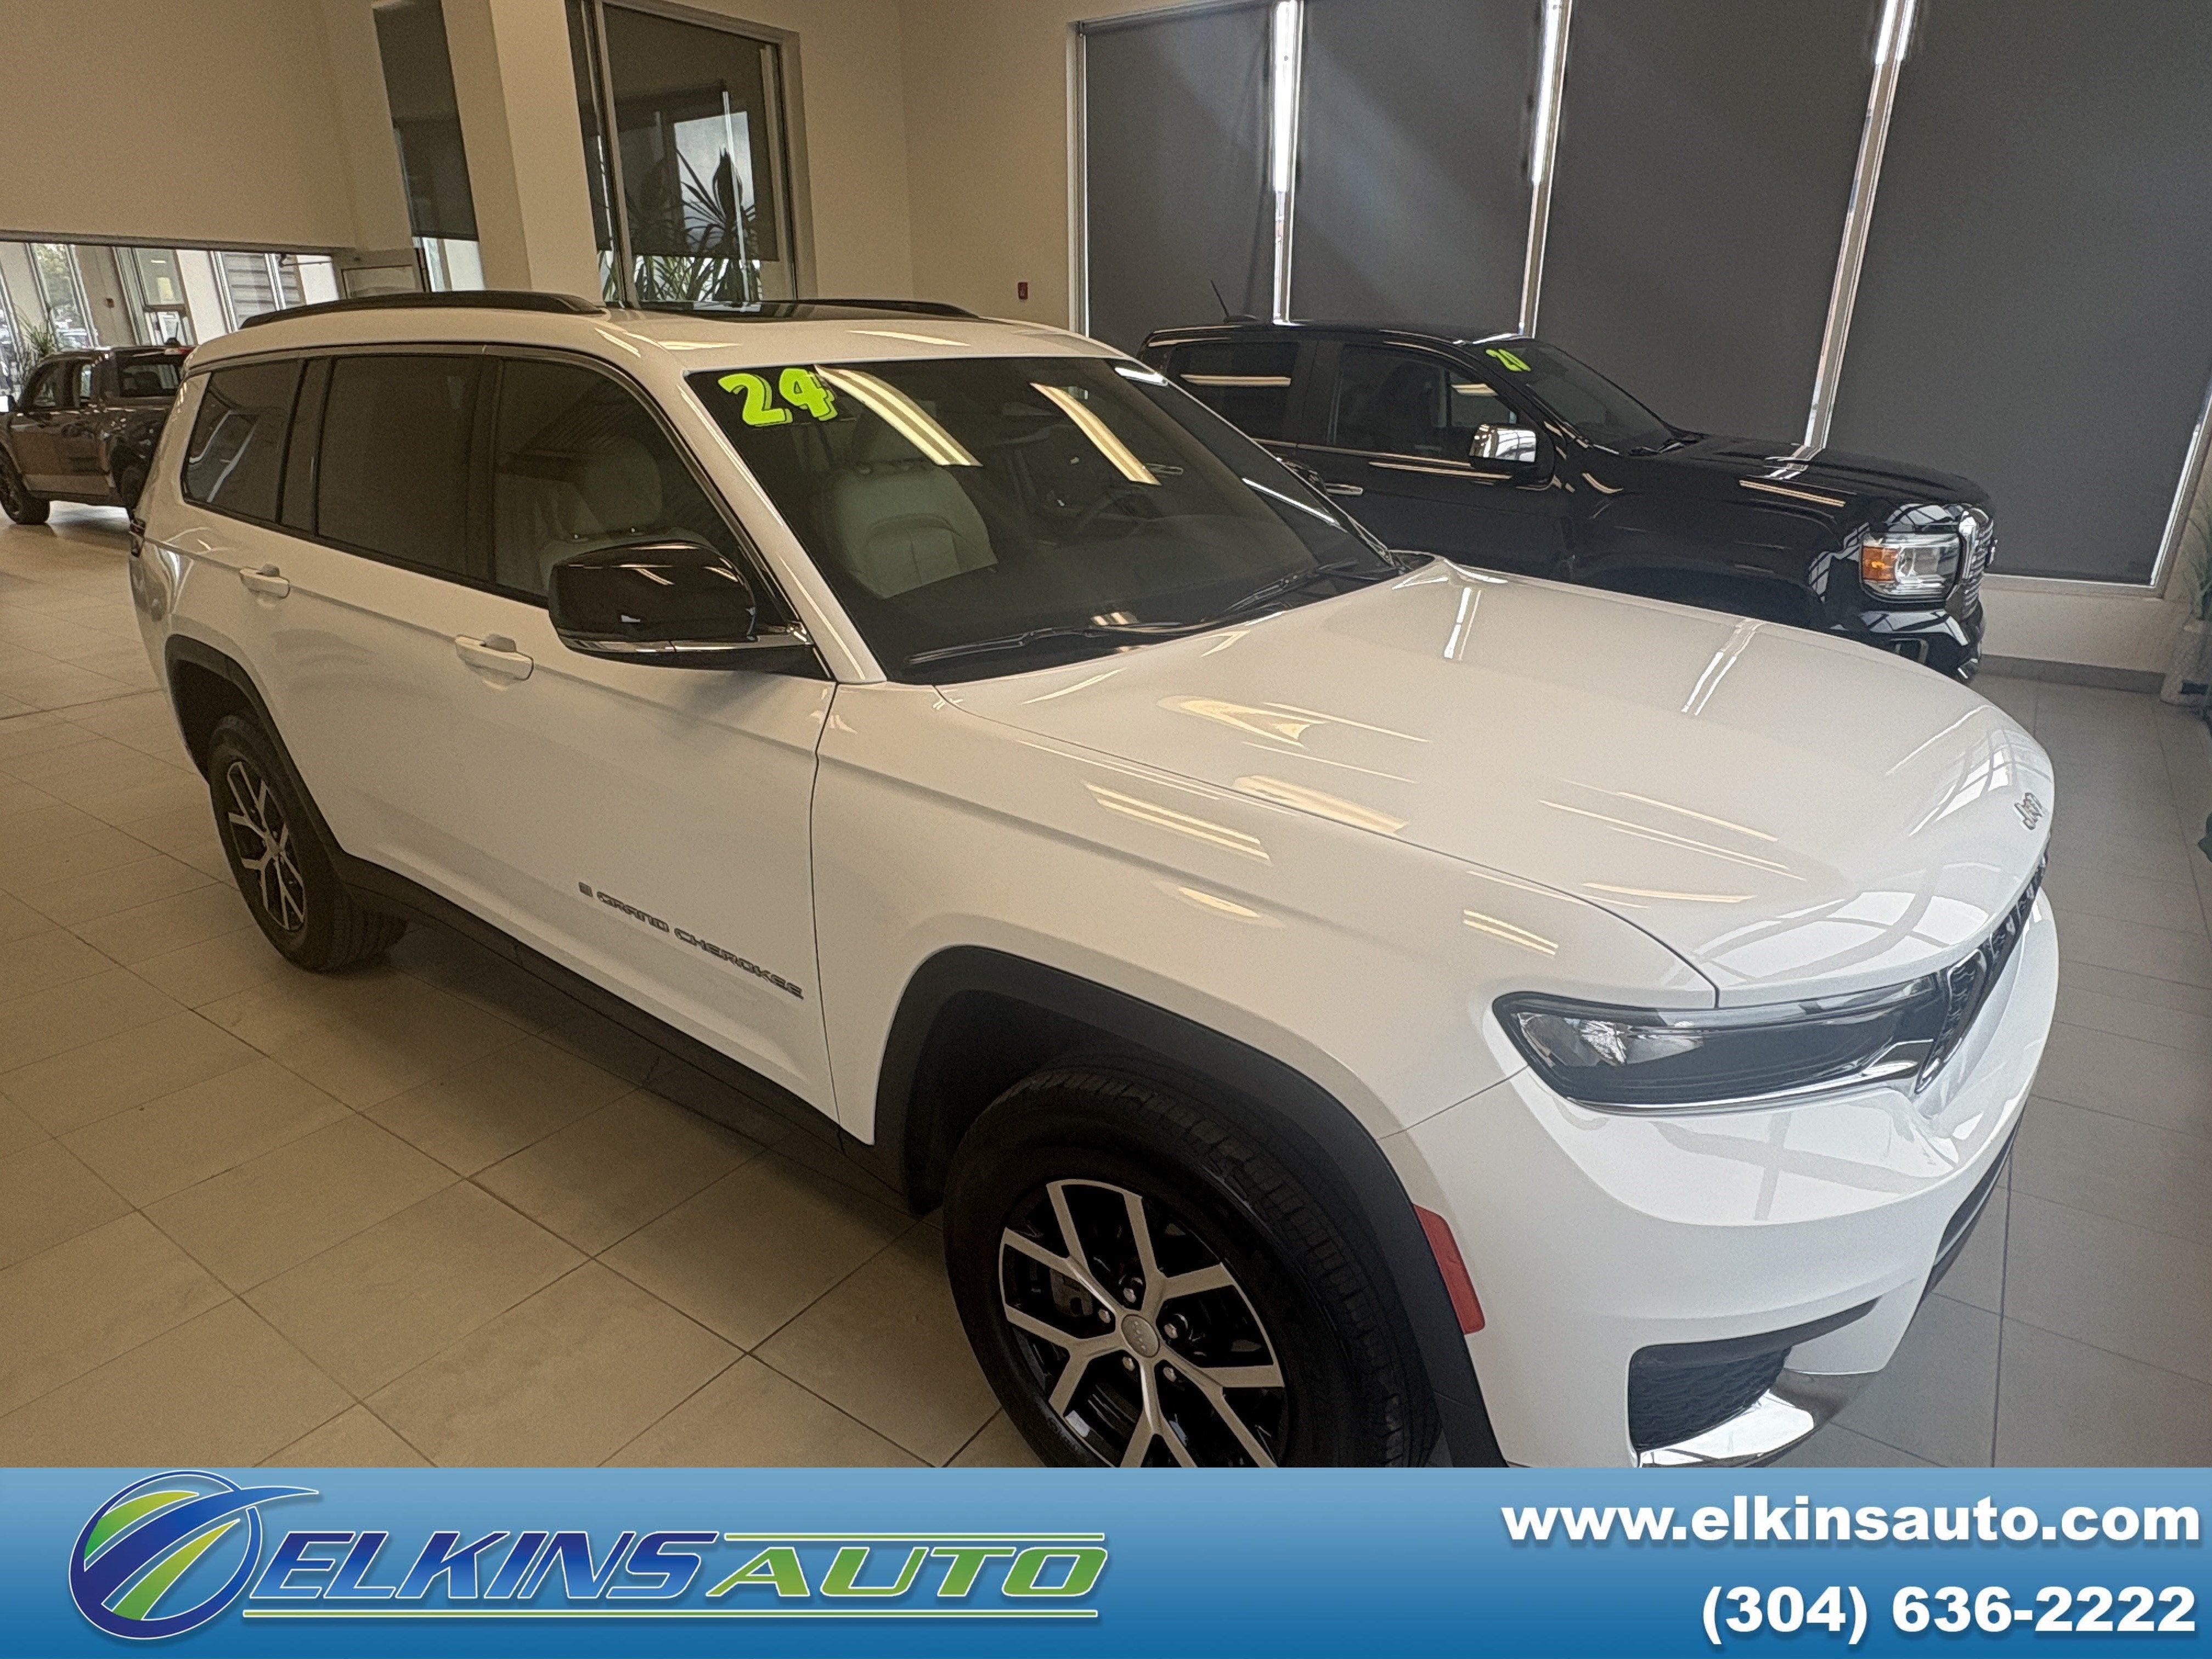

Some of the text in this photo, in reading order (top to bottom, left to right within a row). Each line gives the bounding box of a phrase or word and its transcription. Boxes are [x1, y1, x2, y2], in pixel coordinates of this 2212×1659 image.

[718, 368, 838, 427] 24
[596, 891, 804, 1000] GRAND CHEROKEE
